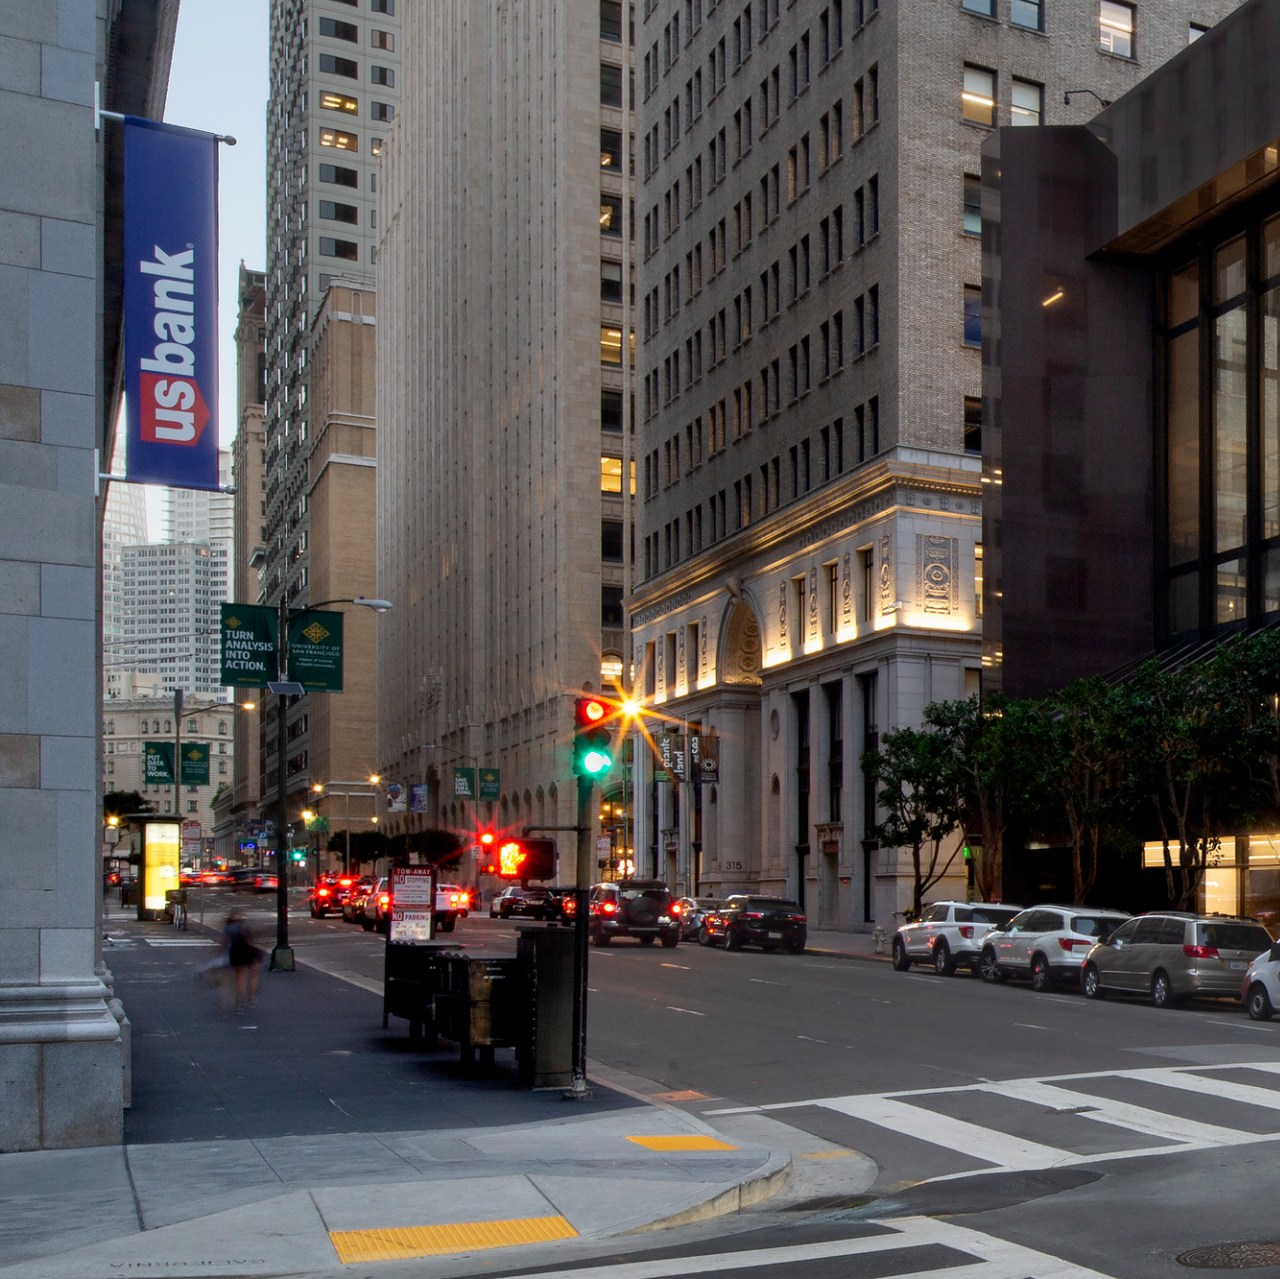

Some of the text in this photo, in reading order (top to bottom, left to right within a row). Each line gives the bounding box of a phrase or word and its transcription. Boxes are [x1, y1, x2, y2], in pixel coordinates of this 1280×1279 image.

[225, 630, 253, 640] TURN
[225, 641, 273, 651] ANALYSIS
[225, 651, 250, 660] INTO
[225, 660, 267, 671] ACTION.
[673, 751, 684, 773] land
[394, 875, 405, 884] NO
[392, 912, 403, 920] NO
